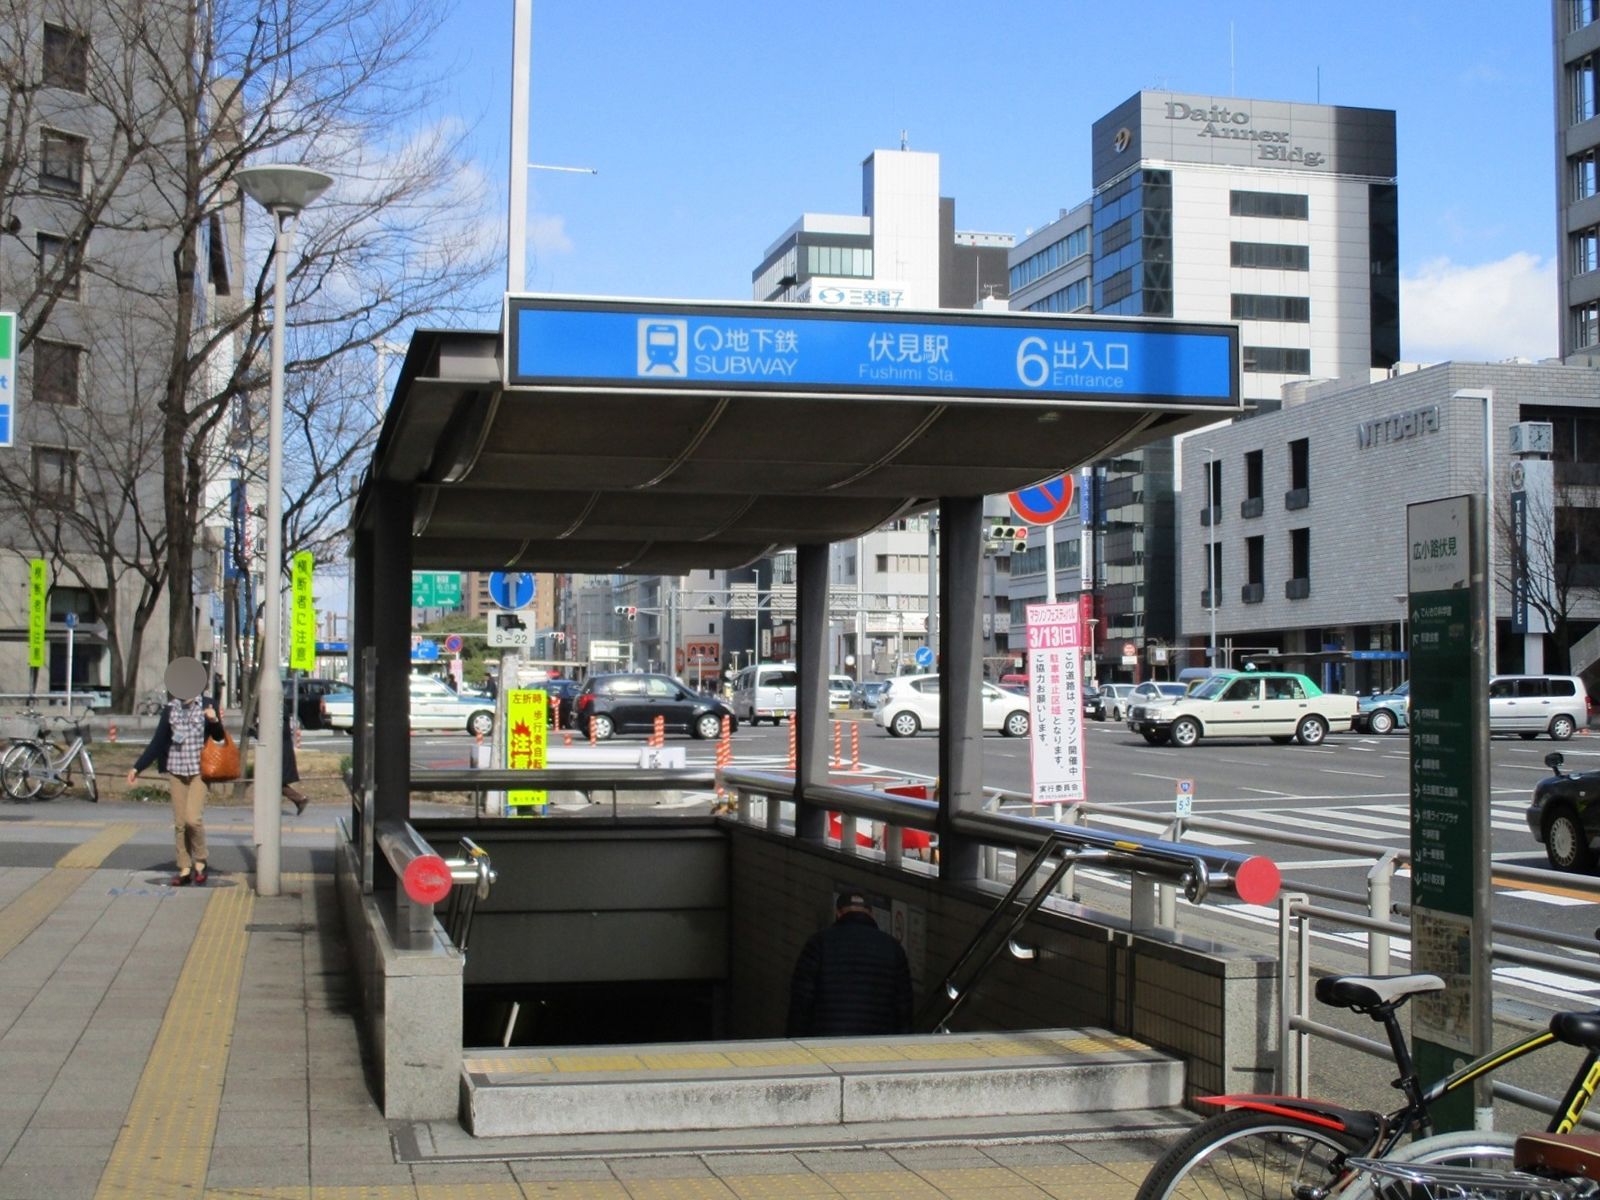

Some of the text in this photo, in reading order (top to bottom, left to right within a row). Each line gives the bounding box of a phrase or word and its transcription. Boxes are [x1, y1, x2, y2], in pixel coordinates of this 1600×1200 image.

[1164, 101, 1249, 125] Daito
[1197, 121, 1290, 144] Annex
[1257, 143, 1326, 167] Bldg.
[726, 328, 799, 353] 地下鉄
[867, 331, 950, 365] 伏見駅
[694, 355, 798, 376] SUBWAY
[1016, 335, 1050, 388] 6
[1053, 340, 1130, 371] 出入口
[859, 364, 922, 381] Fushimi
[1052, 371, 1124, 388] Entrance
[1413, 537, 1457, 560] 広小路伏見
